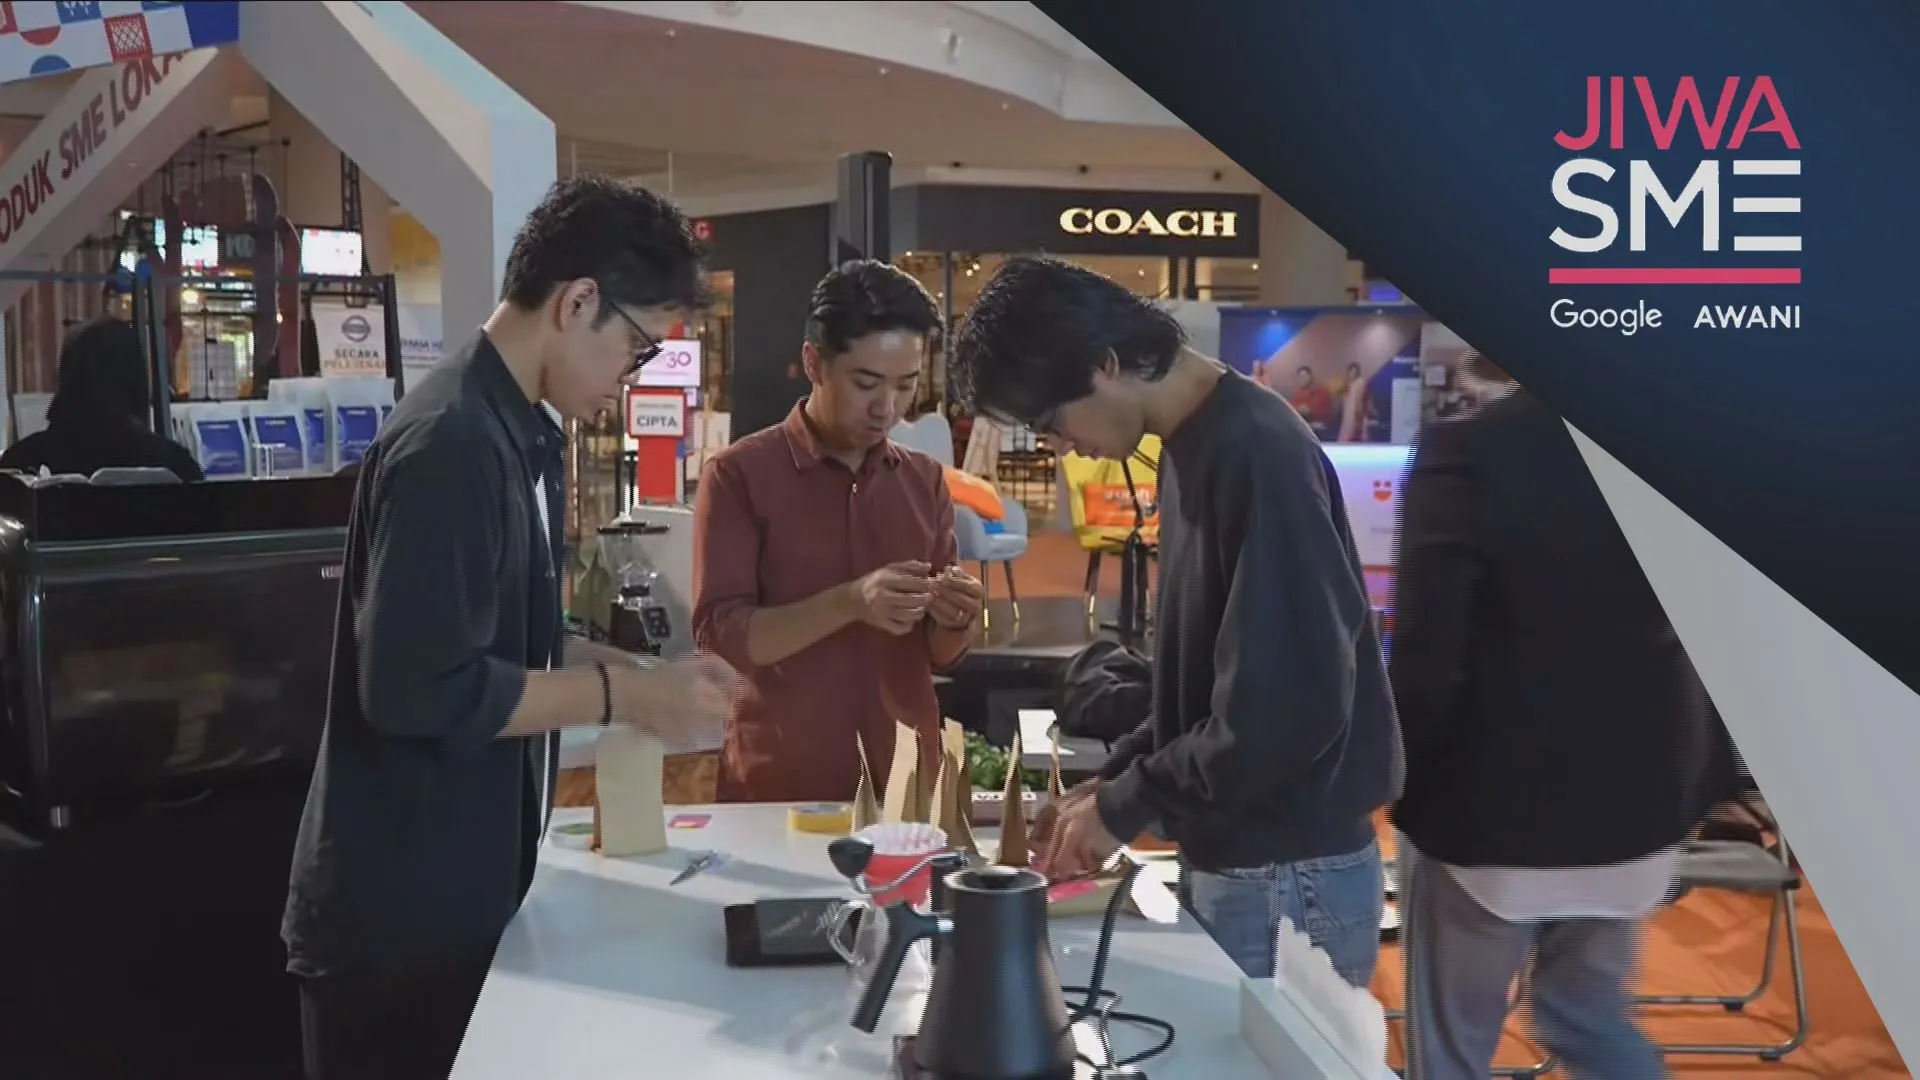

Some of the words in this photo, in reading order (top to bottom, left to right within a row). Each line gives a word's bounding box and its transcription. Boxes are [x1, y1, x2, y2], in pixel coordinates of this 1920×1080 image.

[59, 94, 107, 180] SME
[1059, 207, 1237, 237] COACH
[636, 415, 677, 428] CIPTA
